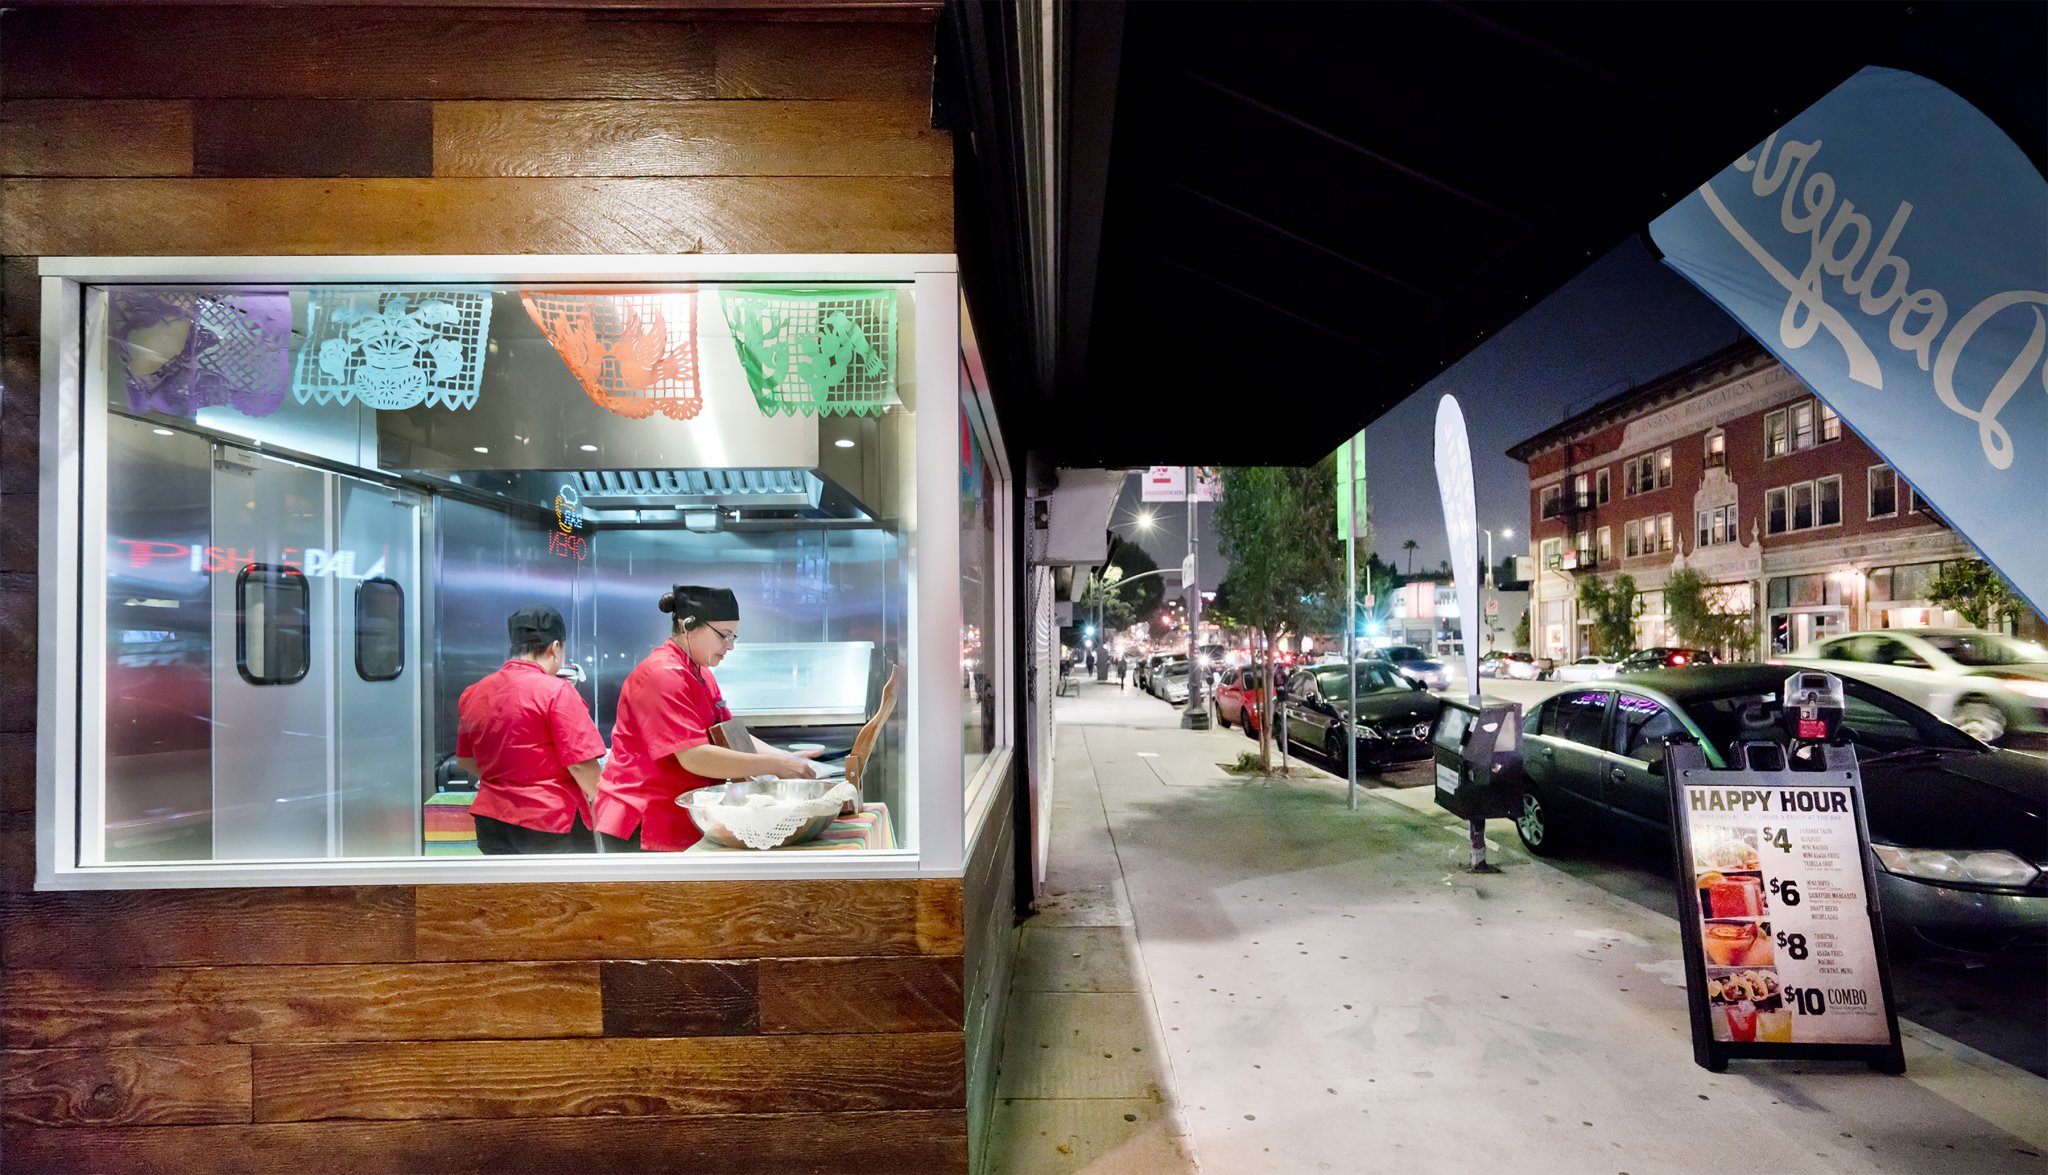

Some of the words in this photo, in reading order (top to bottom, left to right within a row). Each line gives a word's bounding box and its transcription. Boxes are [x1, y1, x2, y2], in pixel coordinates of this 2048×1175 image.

[1690, 790, 1773, 811] HAPPY
[1780, 791, 1848, 812] HOUR
[1763, 826, 1793, 854] $4
[1770, 877, 1800, 906] $6
[1777, 930, 1808, 960] $8
[1784, 984, 1826, 1016] $10
[1828, 988, 1867, 1006] COMBO
